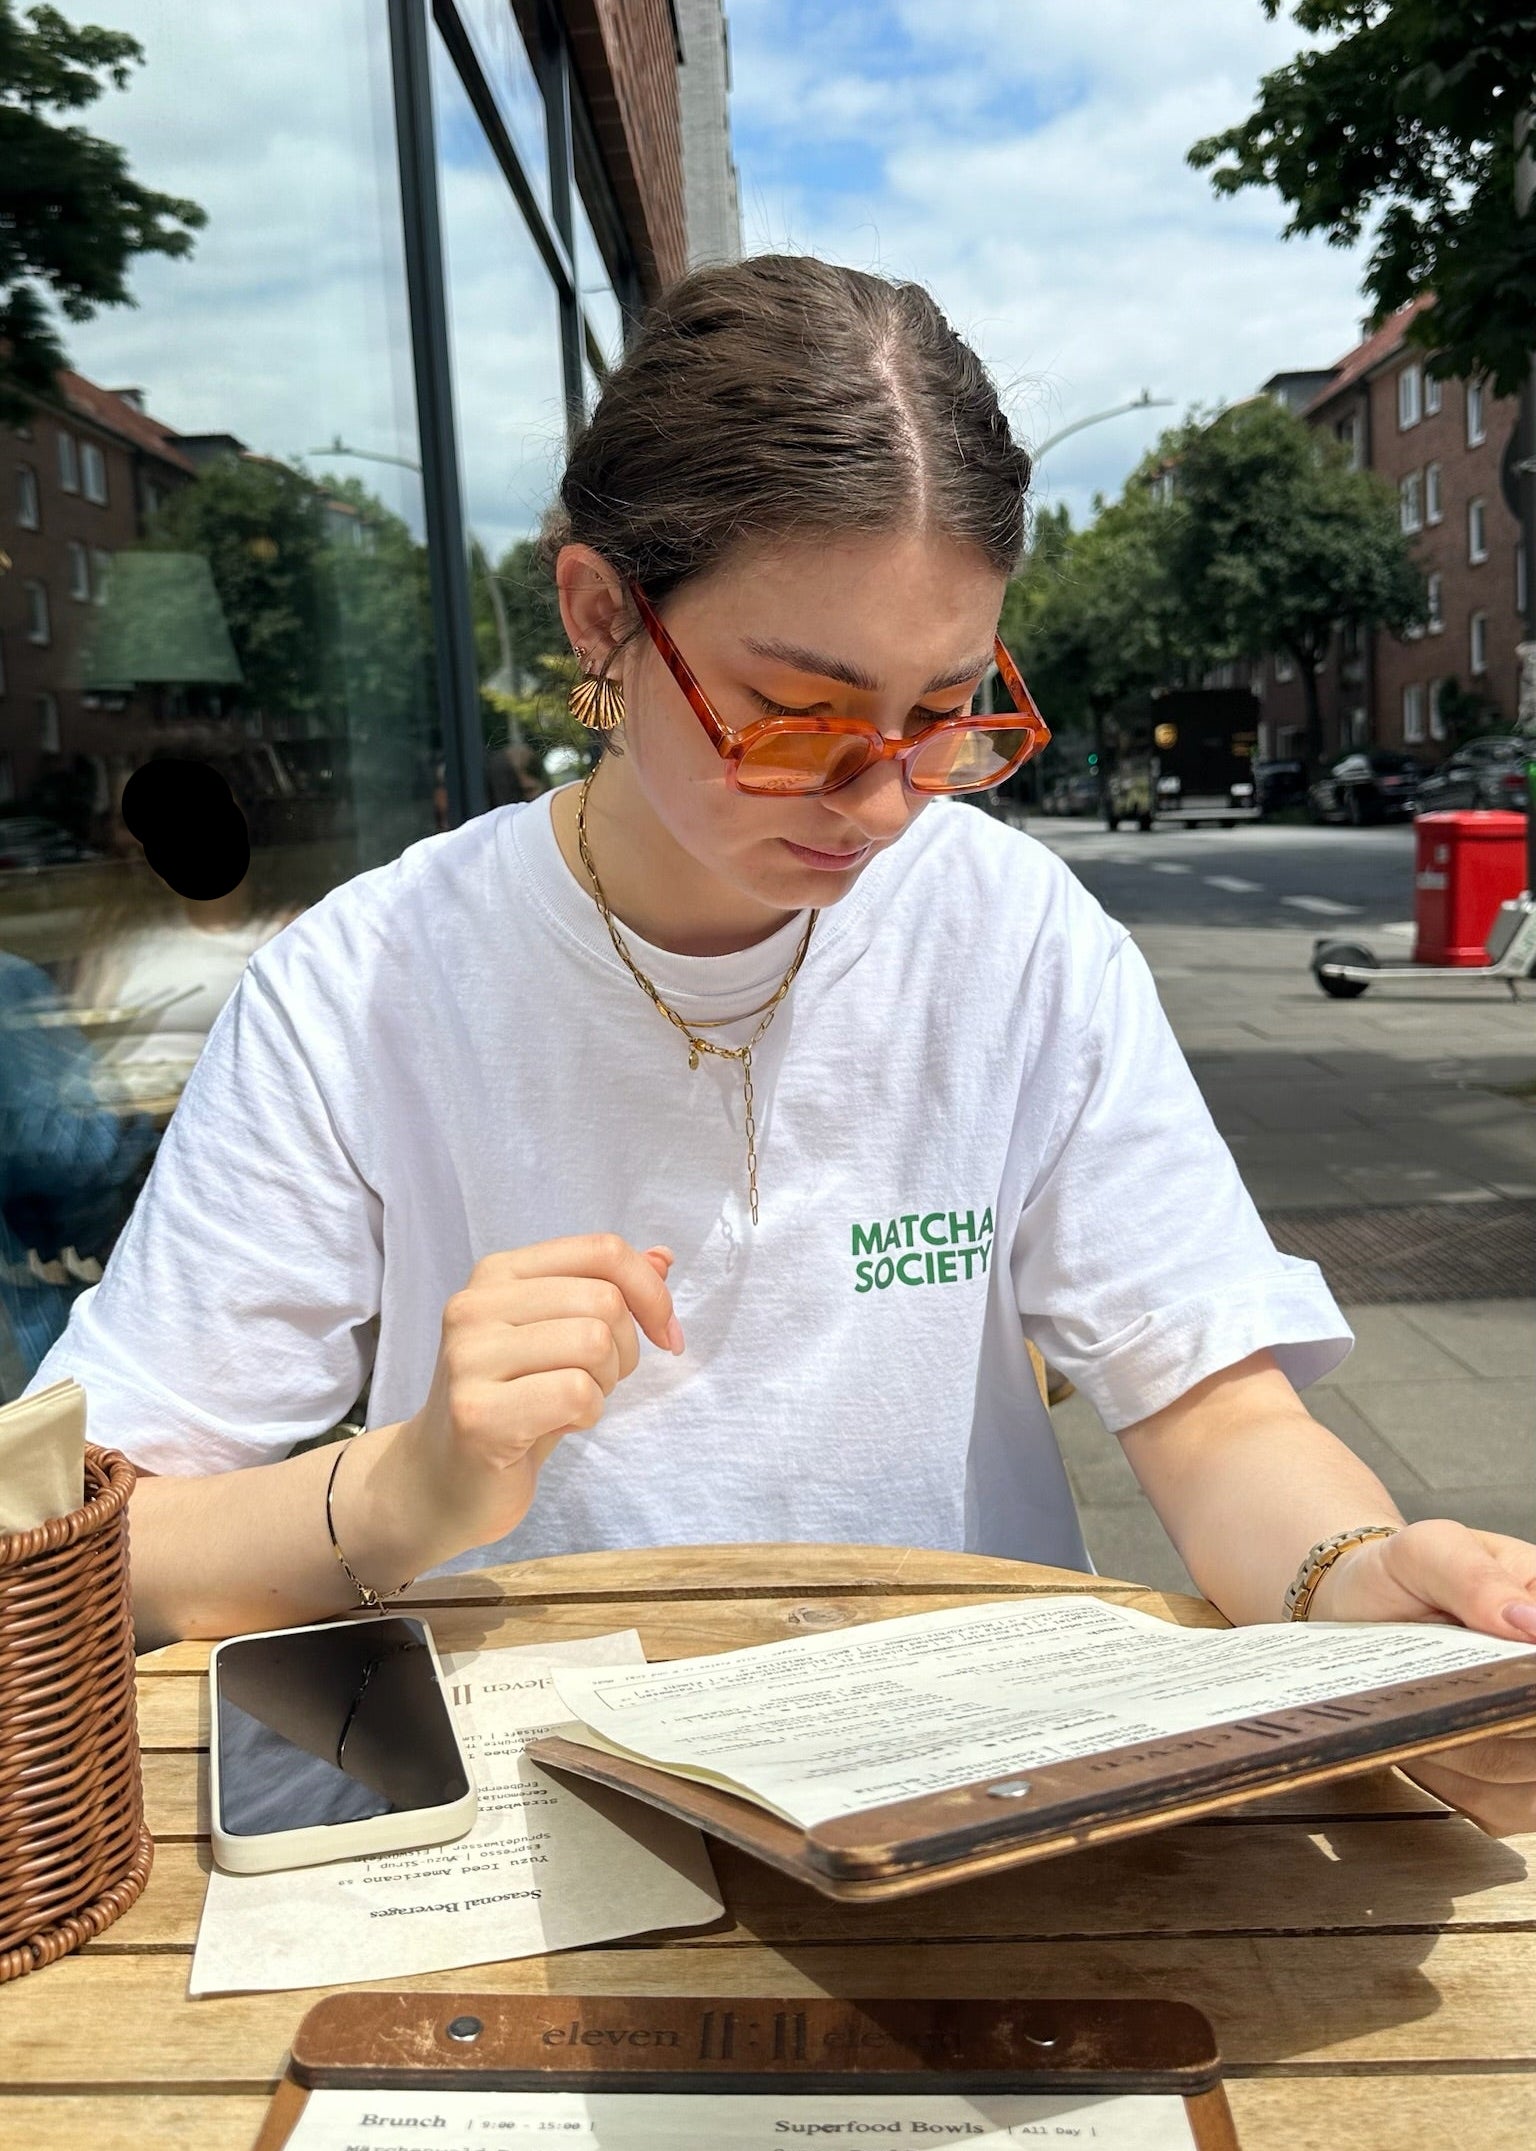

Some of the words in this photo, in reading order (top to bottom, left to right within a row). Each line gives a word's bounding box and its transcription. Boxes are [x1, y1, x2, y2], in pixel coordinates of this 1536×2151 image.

[852, 1206, 994, 1255] MATCHA
[854, 1239, 992, 1293] SOCIETY
[453, 1832, 552, 1851] Sprudelwasser
[480, 1843, 541, 1858] Espresso
[380, 1855, 459, 1870] Yuzu-Sirup
[461, 1862, 500, 1875] Iced
[510, 1854, 550, 1867] Yuzu
[363, 1868, 453, 1885] Americano
[465, 1888, 543, 1906] Seasonal
[370, 1902, 461, 1919] Beverages
[541, 2020, 682, 2048] eleven
[359, 2113, 448, 2128] Brunch
[482, 2121, 517, 2129] 9:00
[537, 2121, 582, 2130] 15:00
[774, 2119, 903, 2135] Superfood
[910, 2120, 985, 2134] Bowls
[1022, 2126, 1048, 2134] All
[1056, 2127, 1081, 2137] Day
